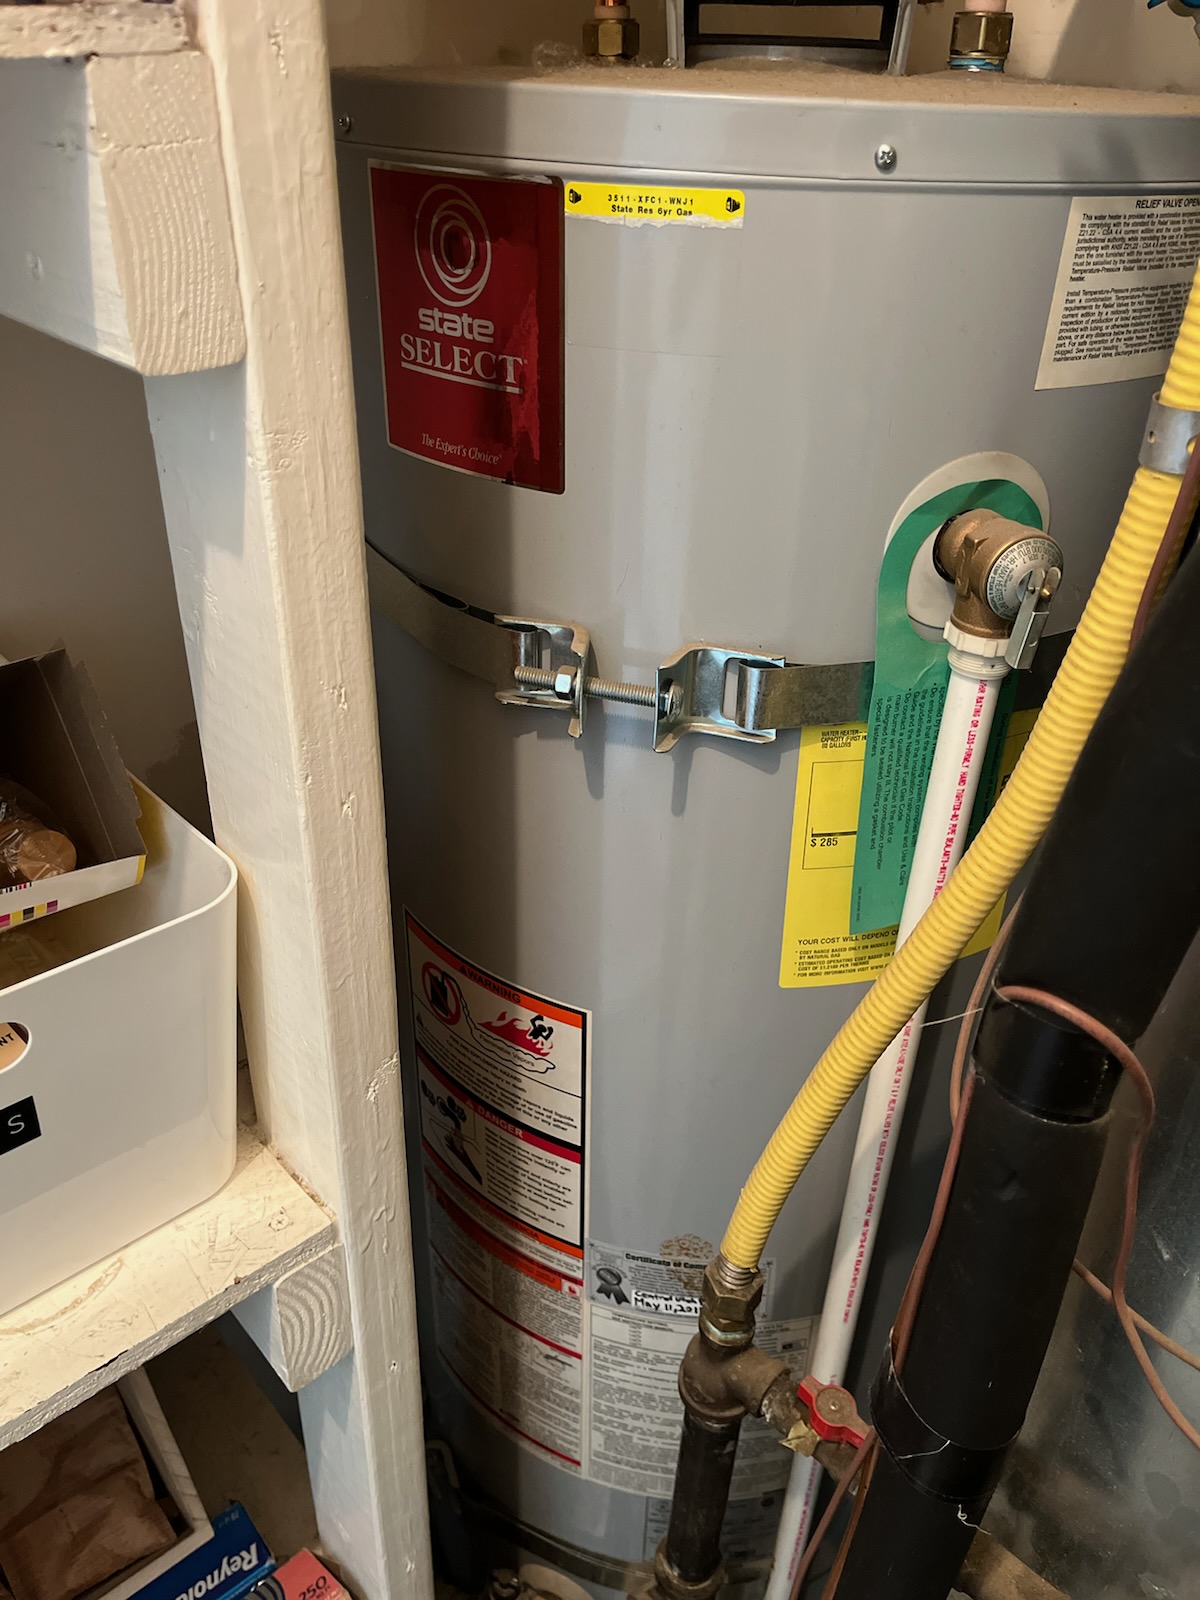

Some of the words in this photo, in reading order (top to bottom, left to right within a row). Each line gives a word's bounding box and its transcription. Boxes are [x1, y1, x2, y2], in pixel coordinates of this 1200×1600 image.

[611, 205, 633, 213] State
[638, 206, 653, 214] Res
[658, 208, 672, 216] 6yr
[676, 208, 692, 216] Gas
[1136, 199, 1161, 208] RELIEF
[1163, 198, 1183, 208] VALVE
[418, 306, 494, 344] state
[400, 332, 524, 384] SELECT
[421, 432, 435, 448] The
[436, 438, 467, 457] Expert's
[468, 447, 500, 465] Choice
[904, 693, 912, 703] Do
[930, 688, 938, 698] Do
[910, 691, 920, 712] Guide
[973, 696, 984, 717] RATING
[875, 698, 883, 723] special
[900, 705, 908, 730] contact
[882, 704, 892, 736] designed
[891, 713, 899, 736] burner
[970, 719, 979, 728] OR
[879, 746, 886, 755] be
[903, 742, 912, 770] National
[918, 754, 927, 778] venting
[958, 771, 968, 786] HAND
[883, 788, 891, 802] The
[947, 823, 957, 835] PIPE
[810, 838, 817, 847] $
[820, 837, 838, 847] 285
[862, 932, 889, 940] DEPEND
[468, 970, 521, 1004] WARNING
[512, 1052, 535, 1067] Vapors
[500, 1069, 522, 1083] HAZARD
[8, 1114, 25, 1134] S
[478, 1106, 523, 1138] DANGER
[625, 1253, 670, 1266] Certificate
[634, 1297, 660, 1311] May
